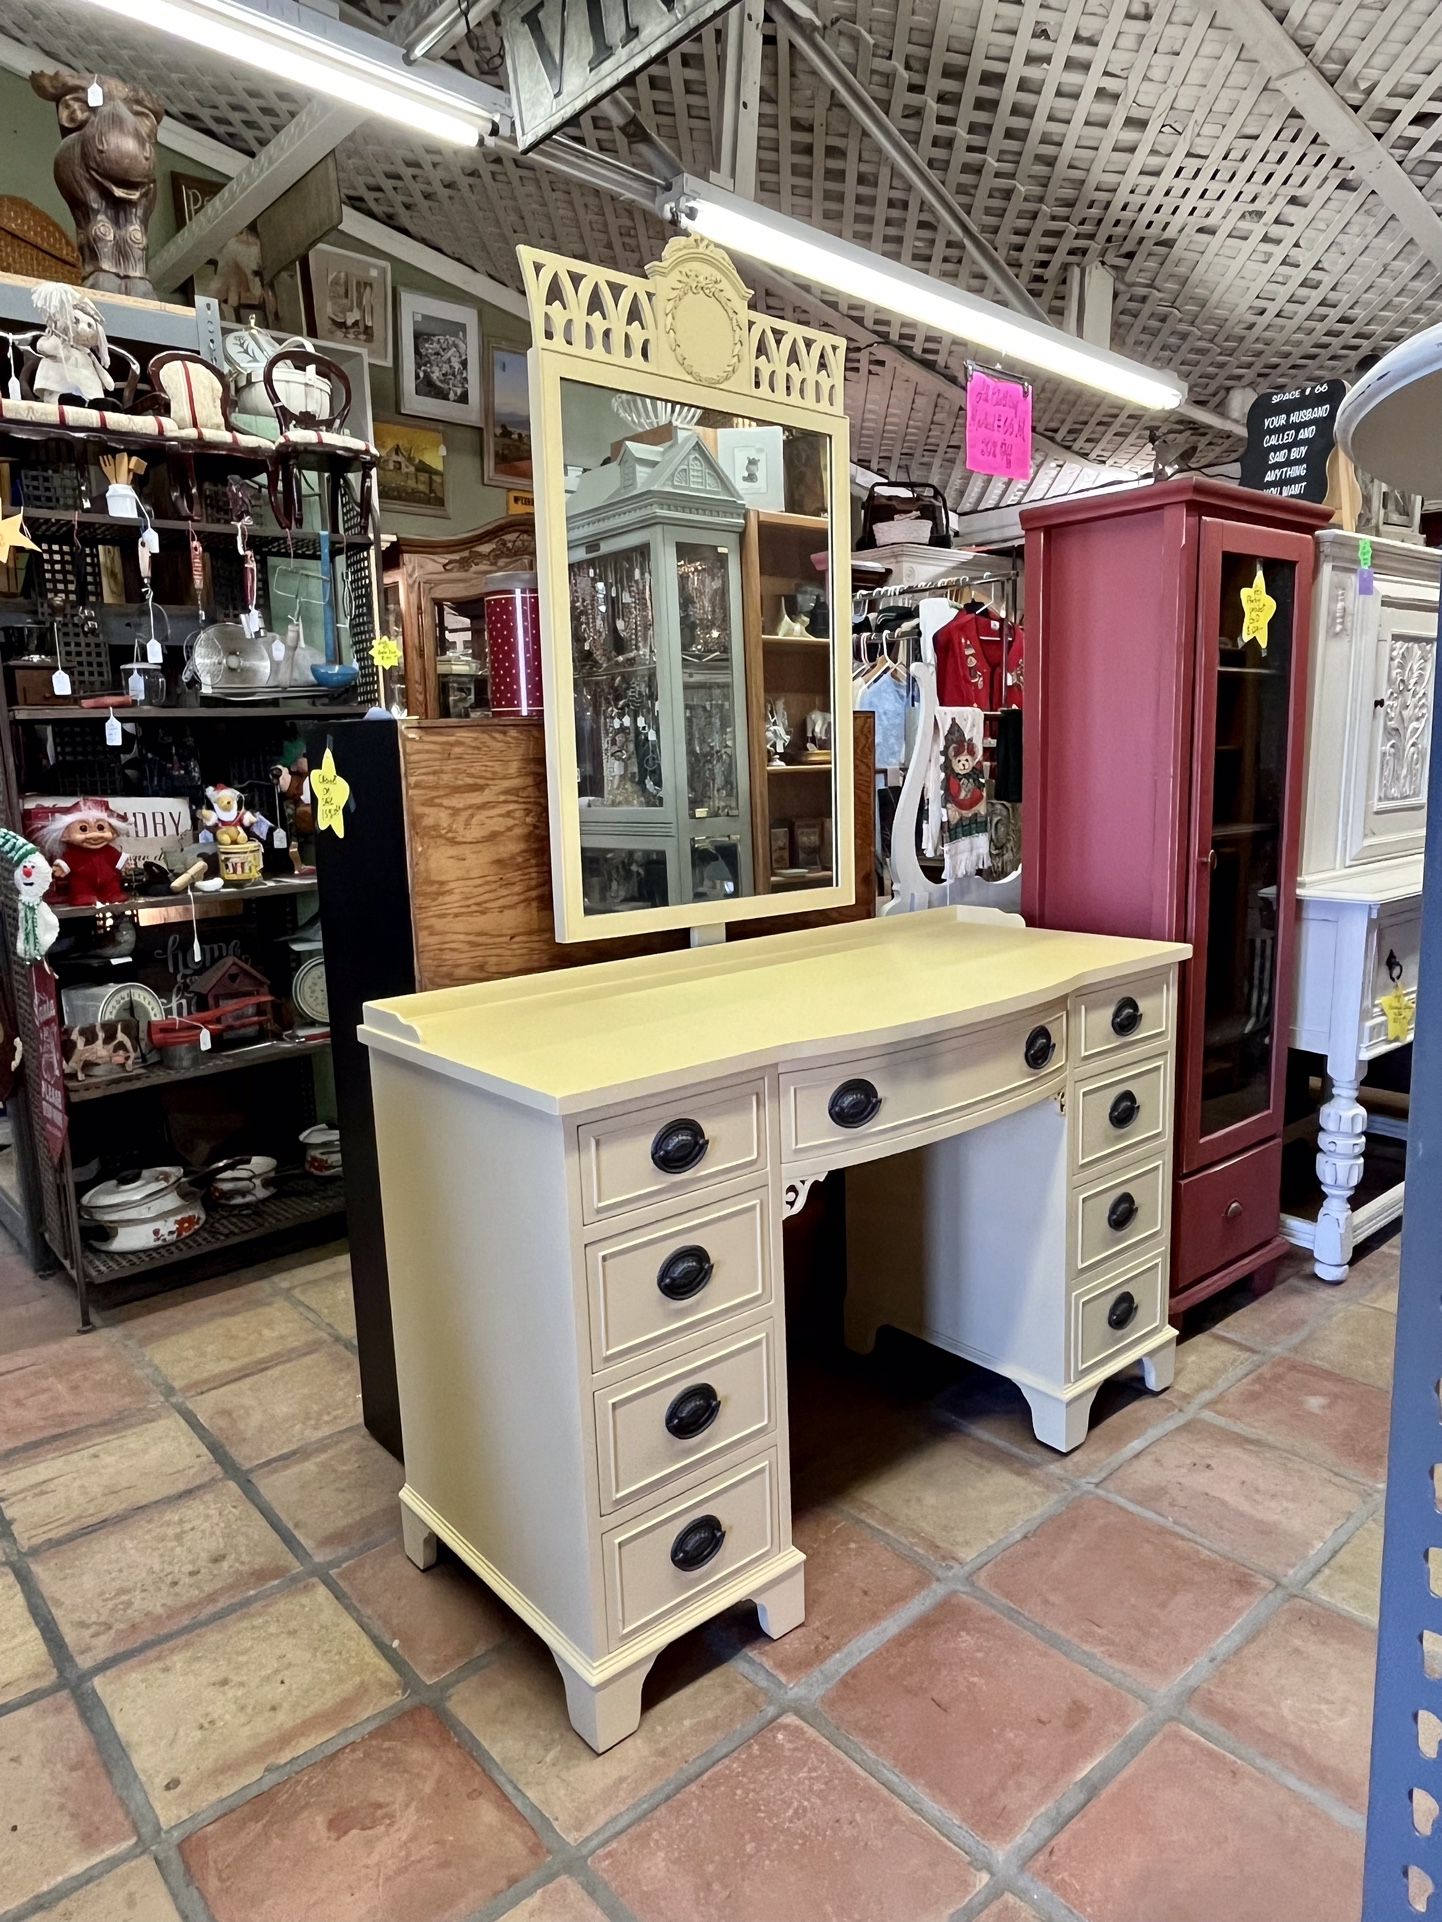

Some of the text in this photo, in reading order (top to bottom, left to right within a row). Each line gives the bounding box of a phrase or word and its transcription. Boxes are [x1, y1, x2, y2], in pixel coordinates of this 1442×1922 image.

[1271, 389, 1301, 404] SPACE
[1314, 382, 1329, 394] 66
[1263, 404, 1330, 430] YOUR HUSBAND
[1263, 425, 1316, 447] CALLED AND
[1268, 445, 1308, 465] SAID BUY
[1264, 464, 1307, 483] ANYTHING
[1281, 481, 1308, 497] WANT
[123, 811, 182, 838] DRY
